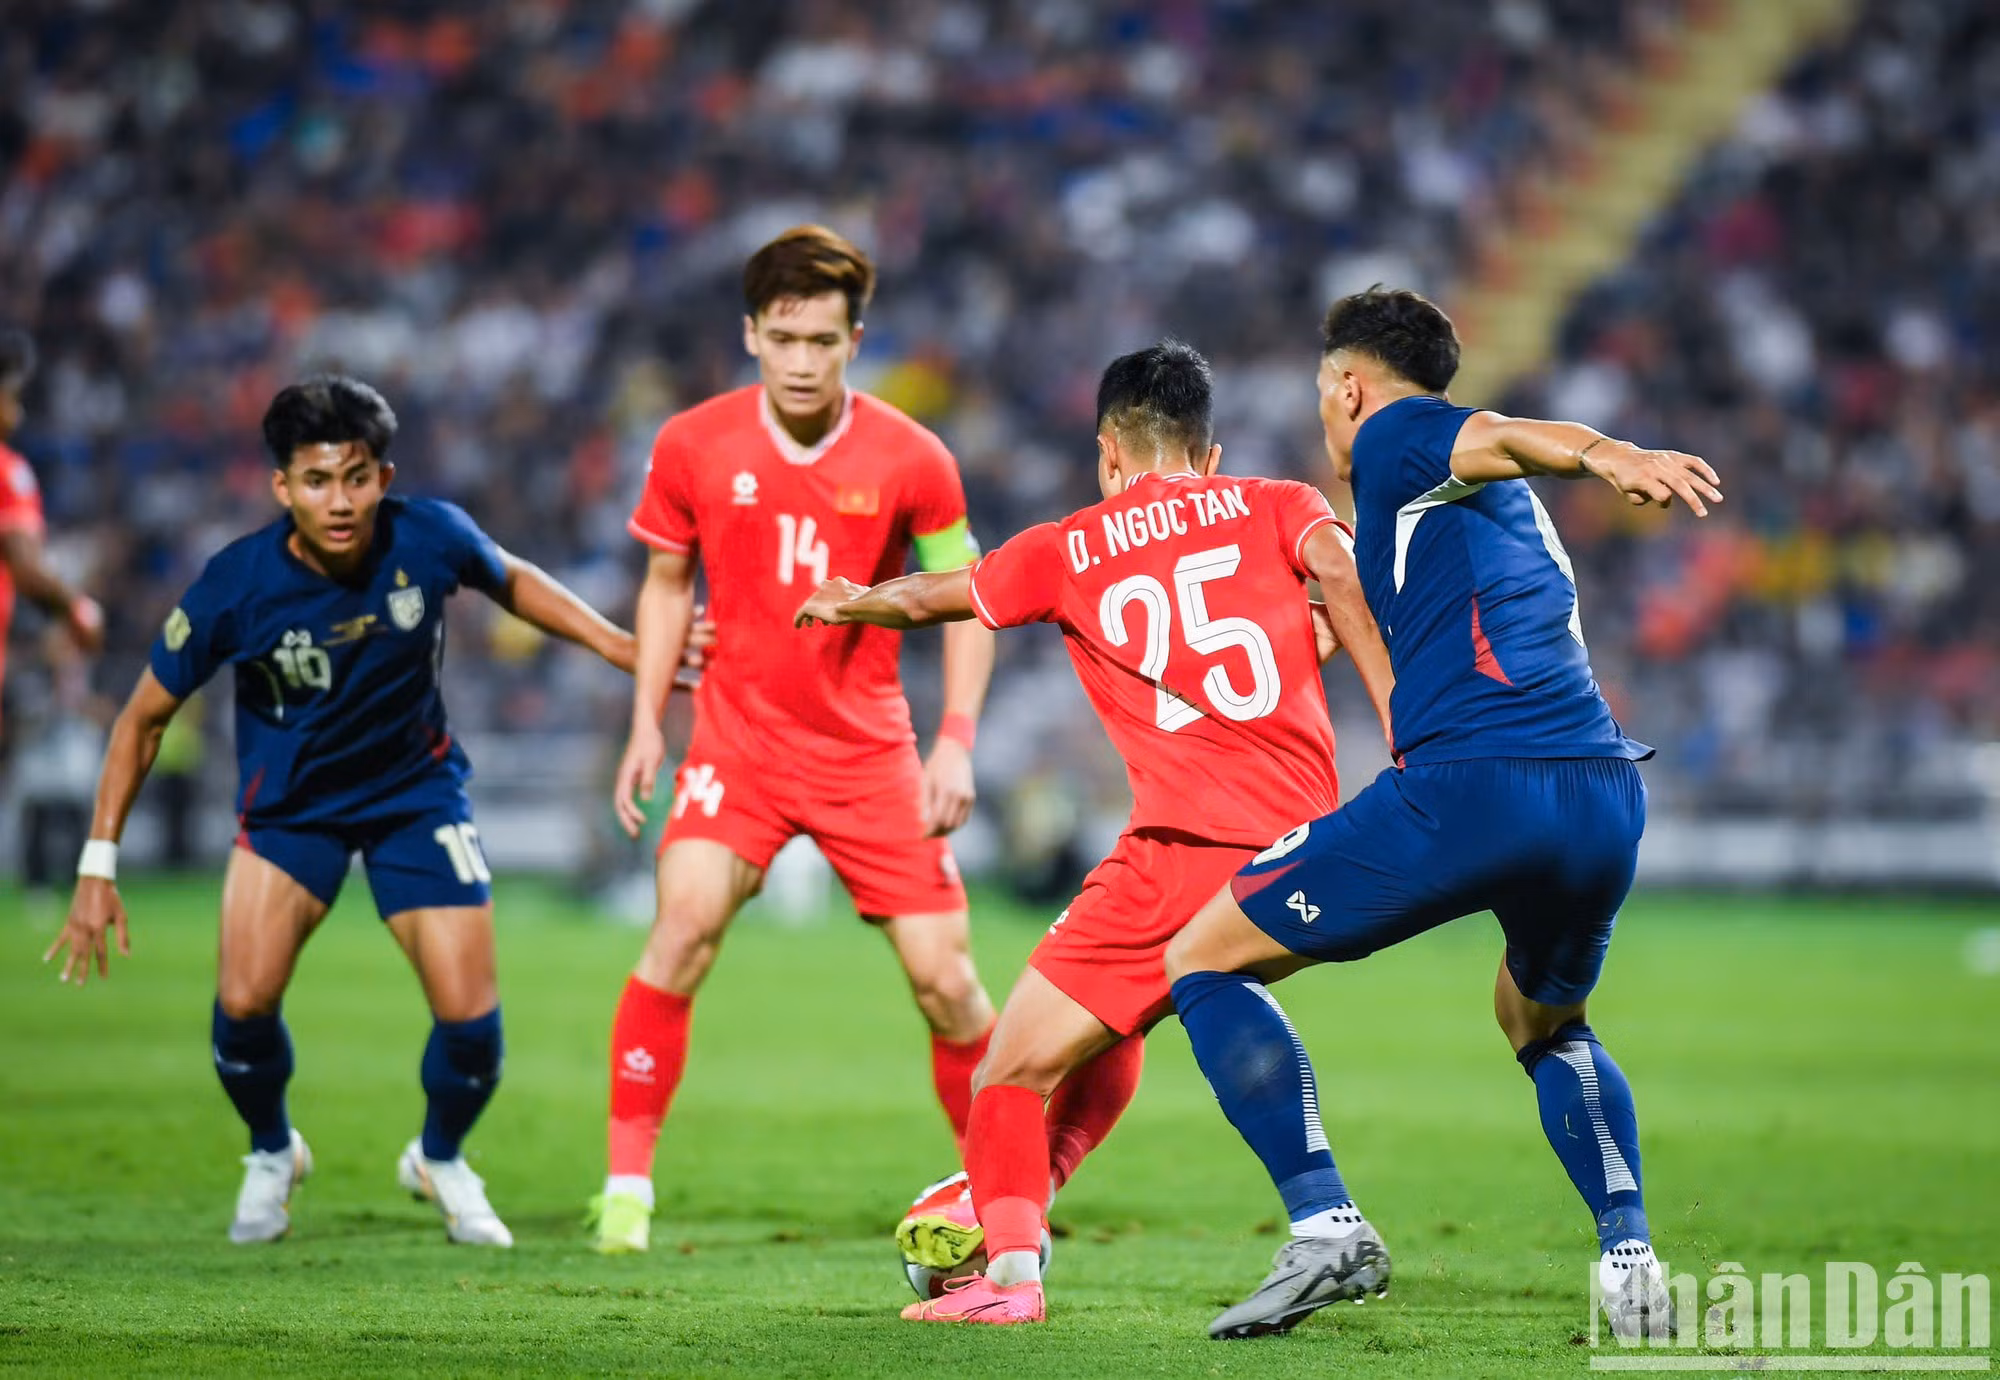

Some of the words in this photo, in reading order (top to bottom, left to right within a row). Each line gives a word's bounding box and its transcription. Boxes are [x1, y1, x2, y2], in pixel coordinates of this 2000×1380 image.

[777, 513, 829, 588] 14
[1068, 529, 1101, 574] D.
[1102, 499, 1188, 557] NGOC
[1187, 485, 1250, 527] TAN
[272, 646, 331, 690] 10
[1099, 543, 1281, 733] 25
[673, 764, 725, 818] 14
[434, 822, 491, 884] 10
